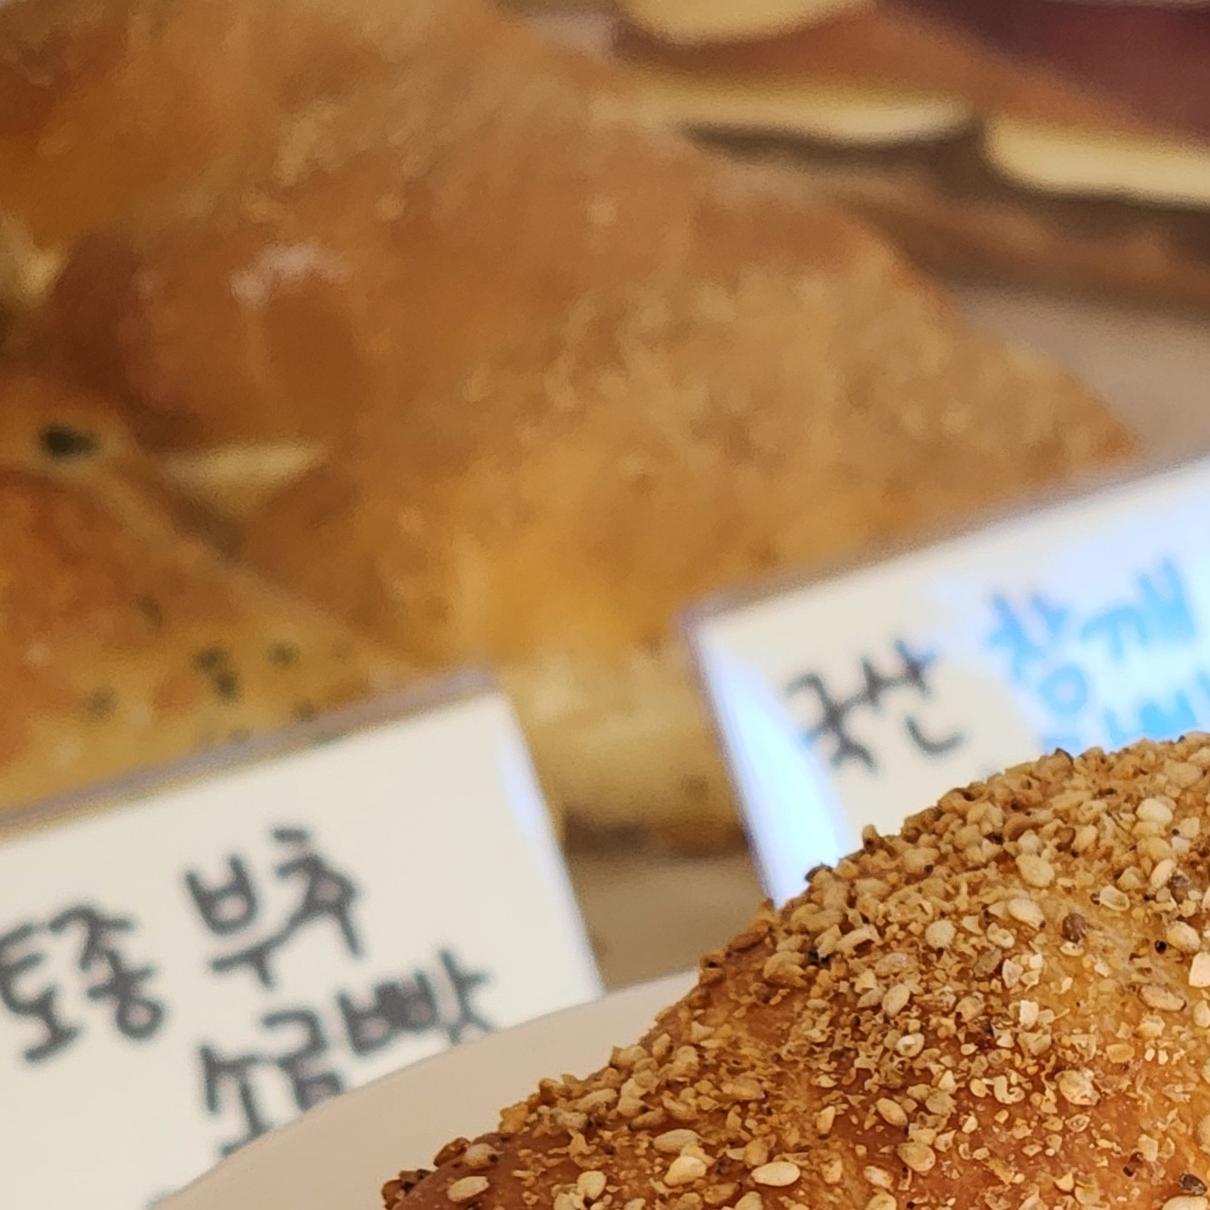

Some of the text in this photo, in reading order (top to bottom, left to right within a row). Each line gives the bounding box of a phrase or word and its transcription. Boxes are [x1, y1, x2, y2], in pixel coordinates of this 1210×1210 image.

[787, 637, 964, 772] 국산
[984, 557, 1197, 716] 참깨
[0, 824, 362, 1067] 토종 부추
[197, 943, 497, 1157] 소금빵
